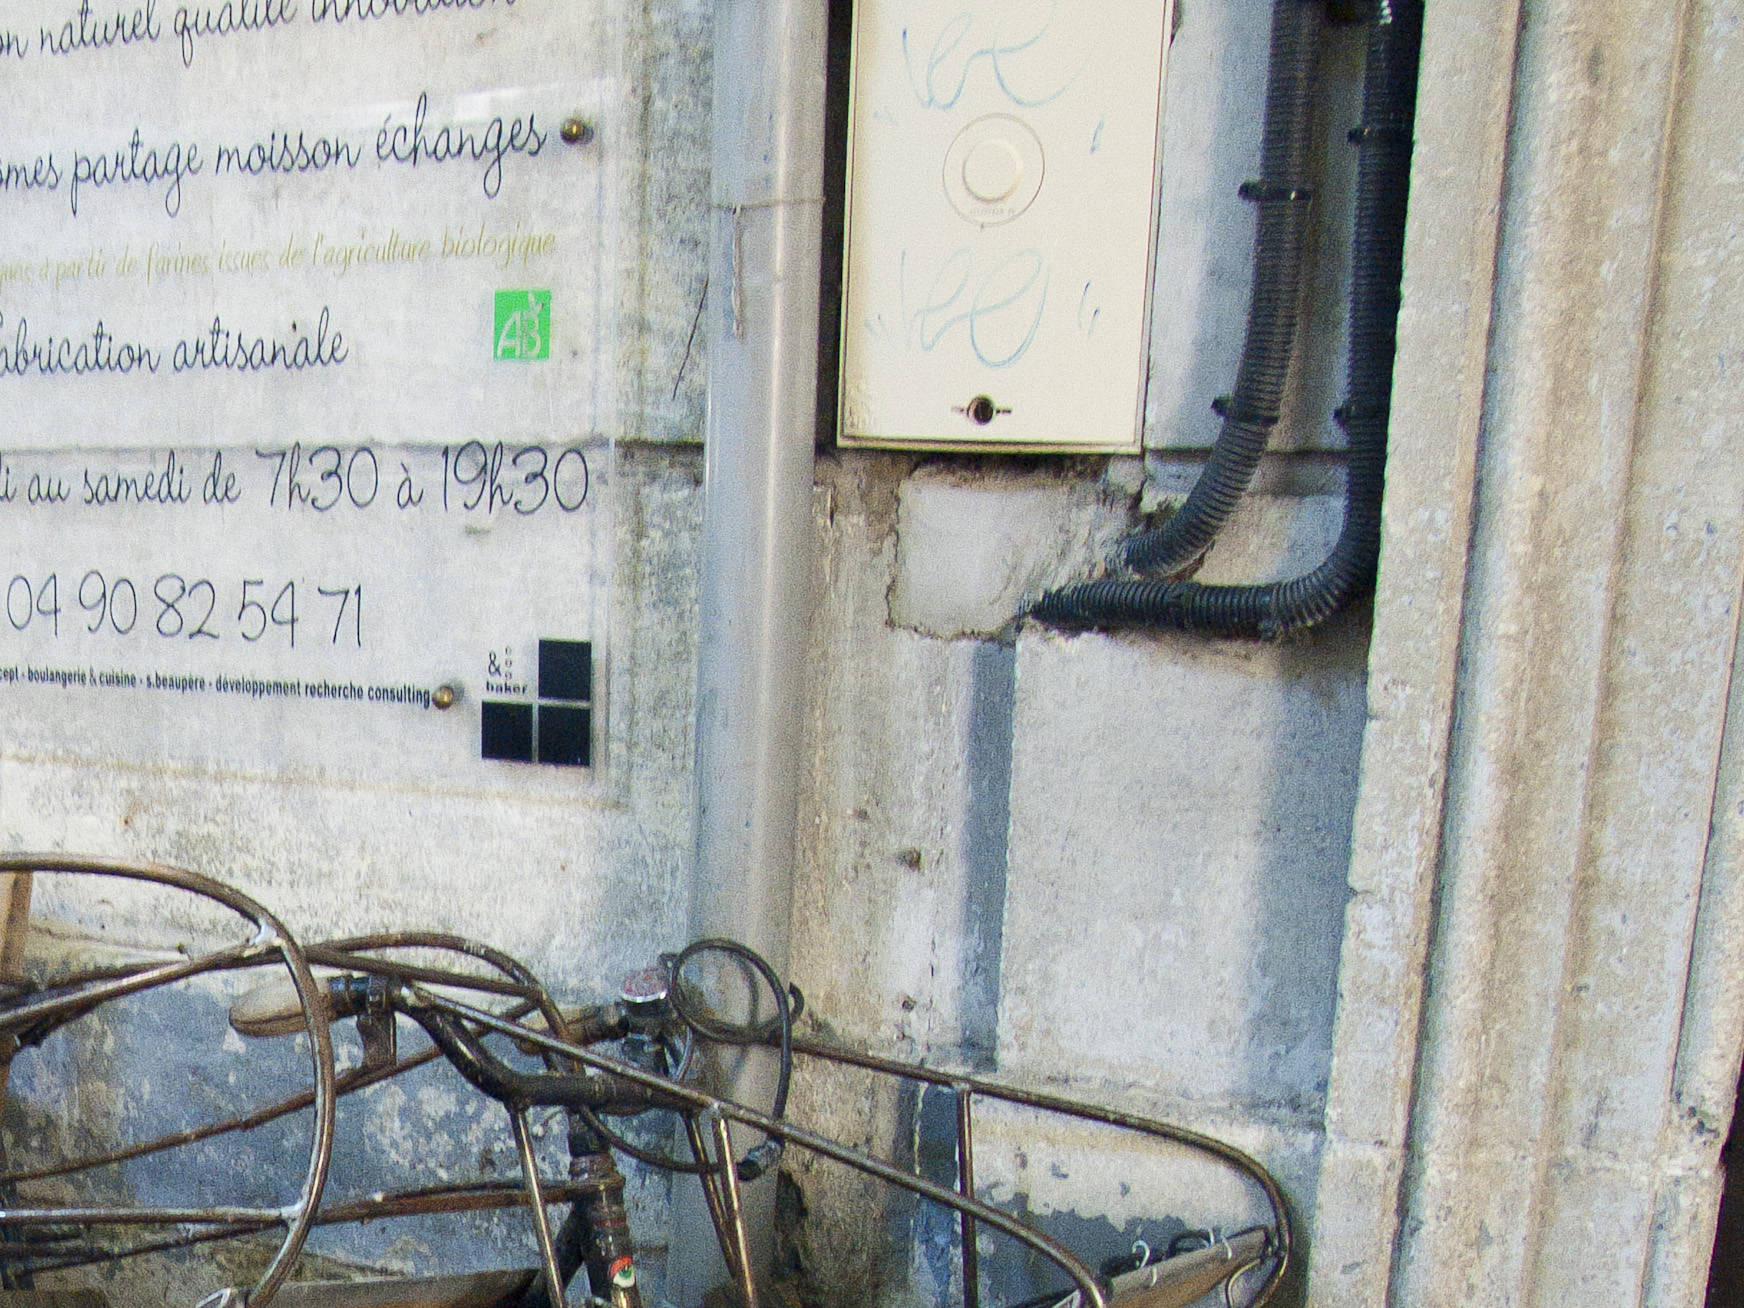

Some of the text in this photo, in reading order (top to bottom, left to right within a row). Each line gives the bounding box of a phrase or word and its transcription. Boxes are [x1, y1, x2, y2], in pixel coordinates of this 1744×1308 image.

[39, 0, 162, 56] naturel
[69, 126, 204, 218] partage
[214, 129, 362, 176] moisson
[374, 91, 548, 200] échanges
[115, 241, 137, 276] de
[278, 232, 305, 268] de
[312, 227, 432, 277] l'agriculture
[441, 221, 557, 271] biologique
[172, 305, 349, 375] artisanale
[27, 472, 72, 505] au
[83, 448, 192, 506] samedi
[203, 449, 242, 505] de
[255, 441, 380, 513] 7h30
[397, 462, 424, 510] à
[441, 440, 590, 515] 19h30
[6, 571, 62, 638] 04
[78, 568, 138, 635] 90
[153, 572, 220, 639] 82
[237, 578, 299, 649] 54
[317, 583, 363, 649] 71
[27, 664, 87, 690] boulangerie
[98, 667, 137, 689] cuisine
[215, 671, 301, 700] développement
[304, 678, 364, 702] recherche
[367, 683, 431, 710] consulting
[485, 679, 529, 696] baker
